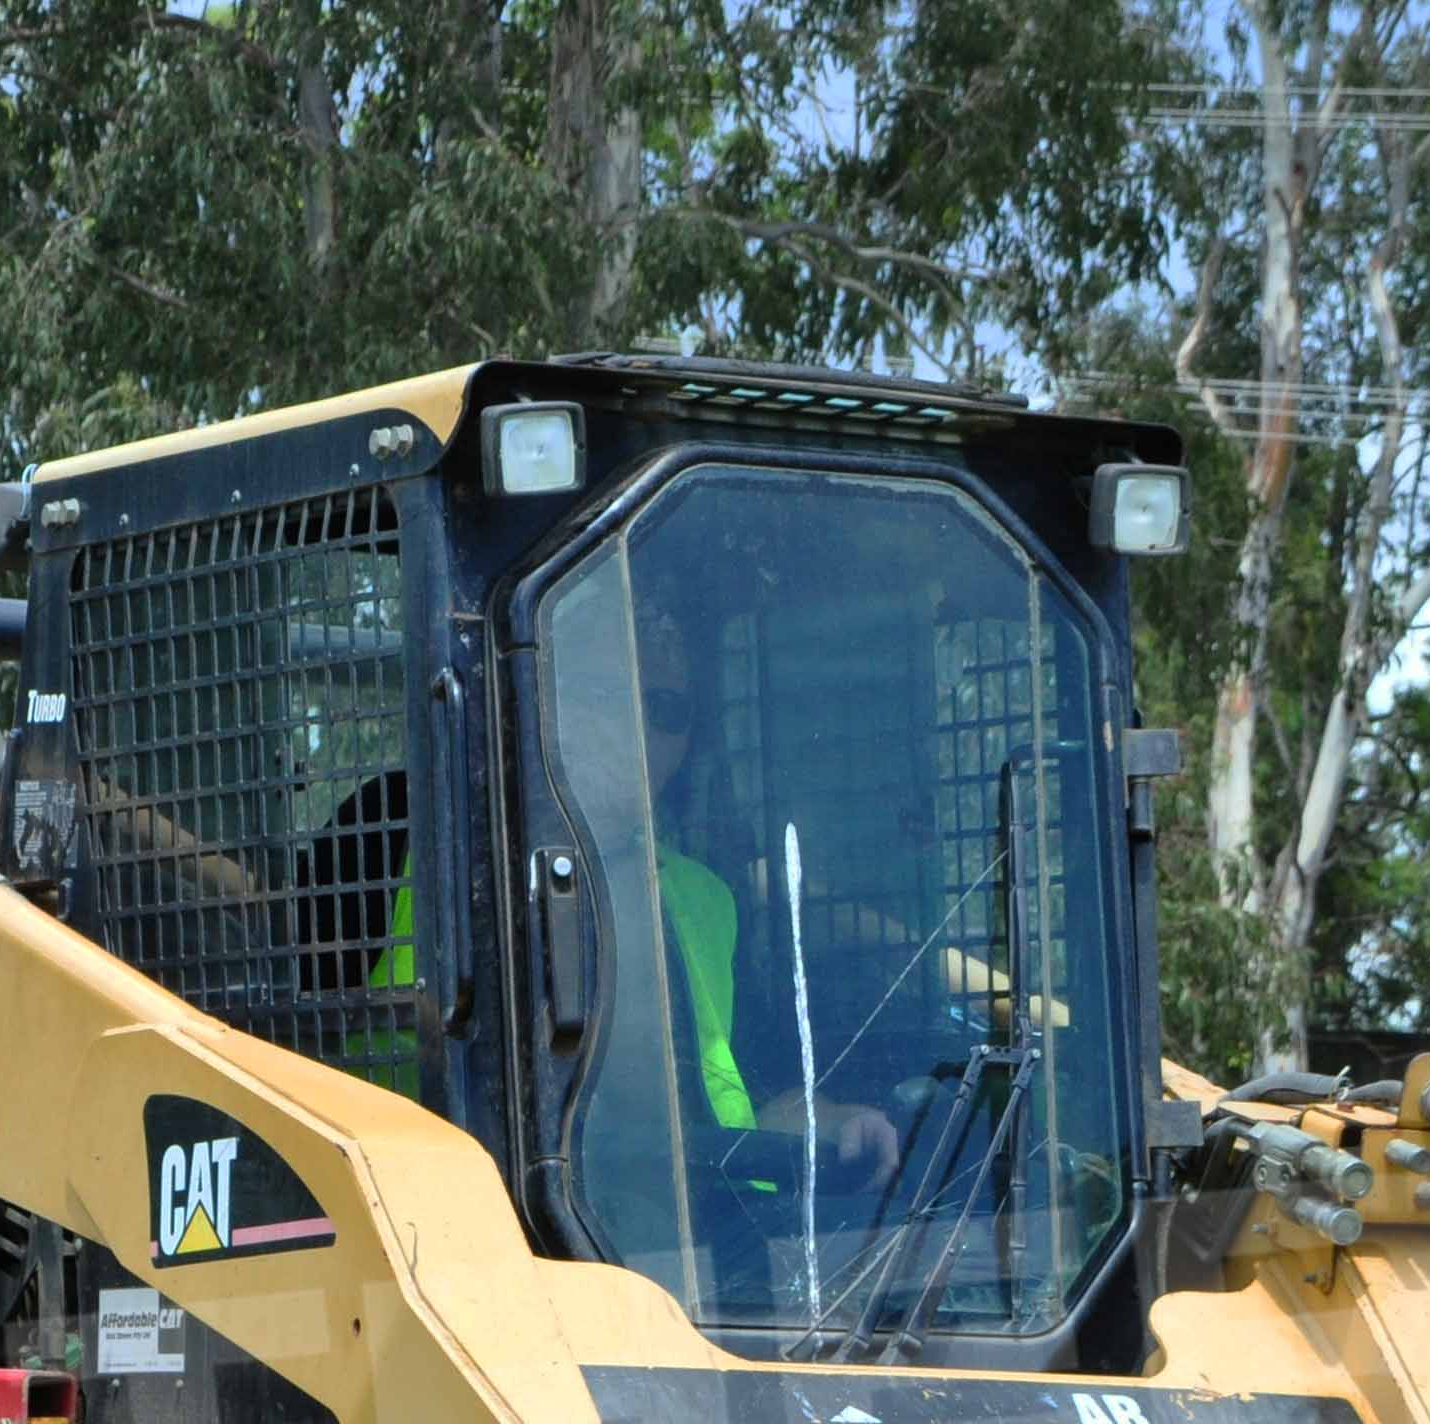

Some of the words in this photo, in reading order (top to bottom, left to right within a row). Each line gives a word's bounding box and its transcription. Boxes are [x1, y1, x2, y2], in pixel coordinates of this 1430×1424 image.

[26, 689, 67, 723] TURBO
[159, 1136, 240, 1257] CAT
[100, 1312, 158, 1329] Affordable
[159, 1308, 184, 1329] CAT
